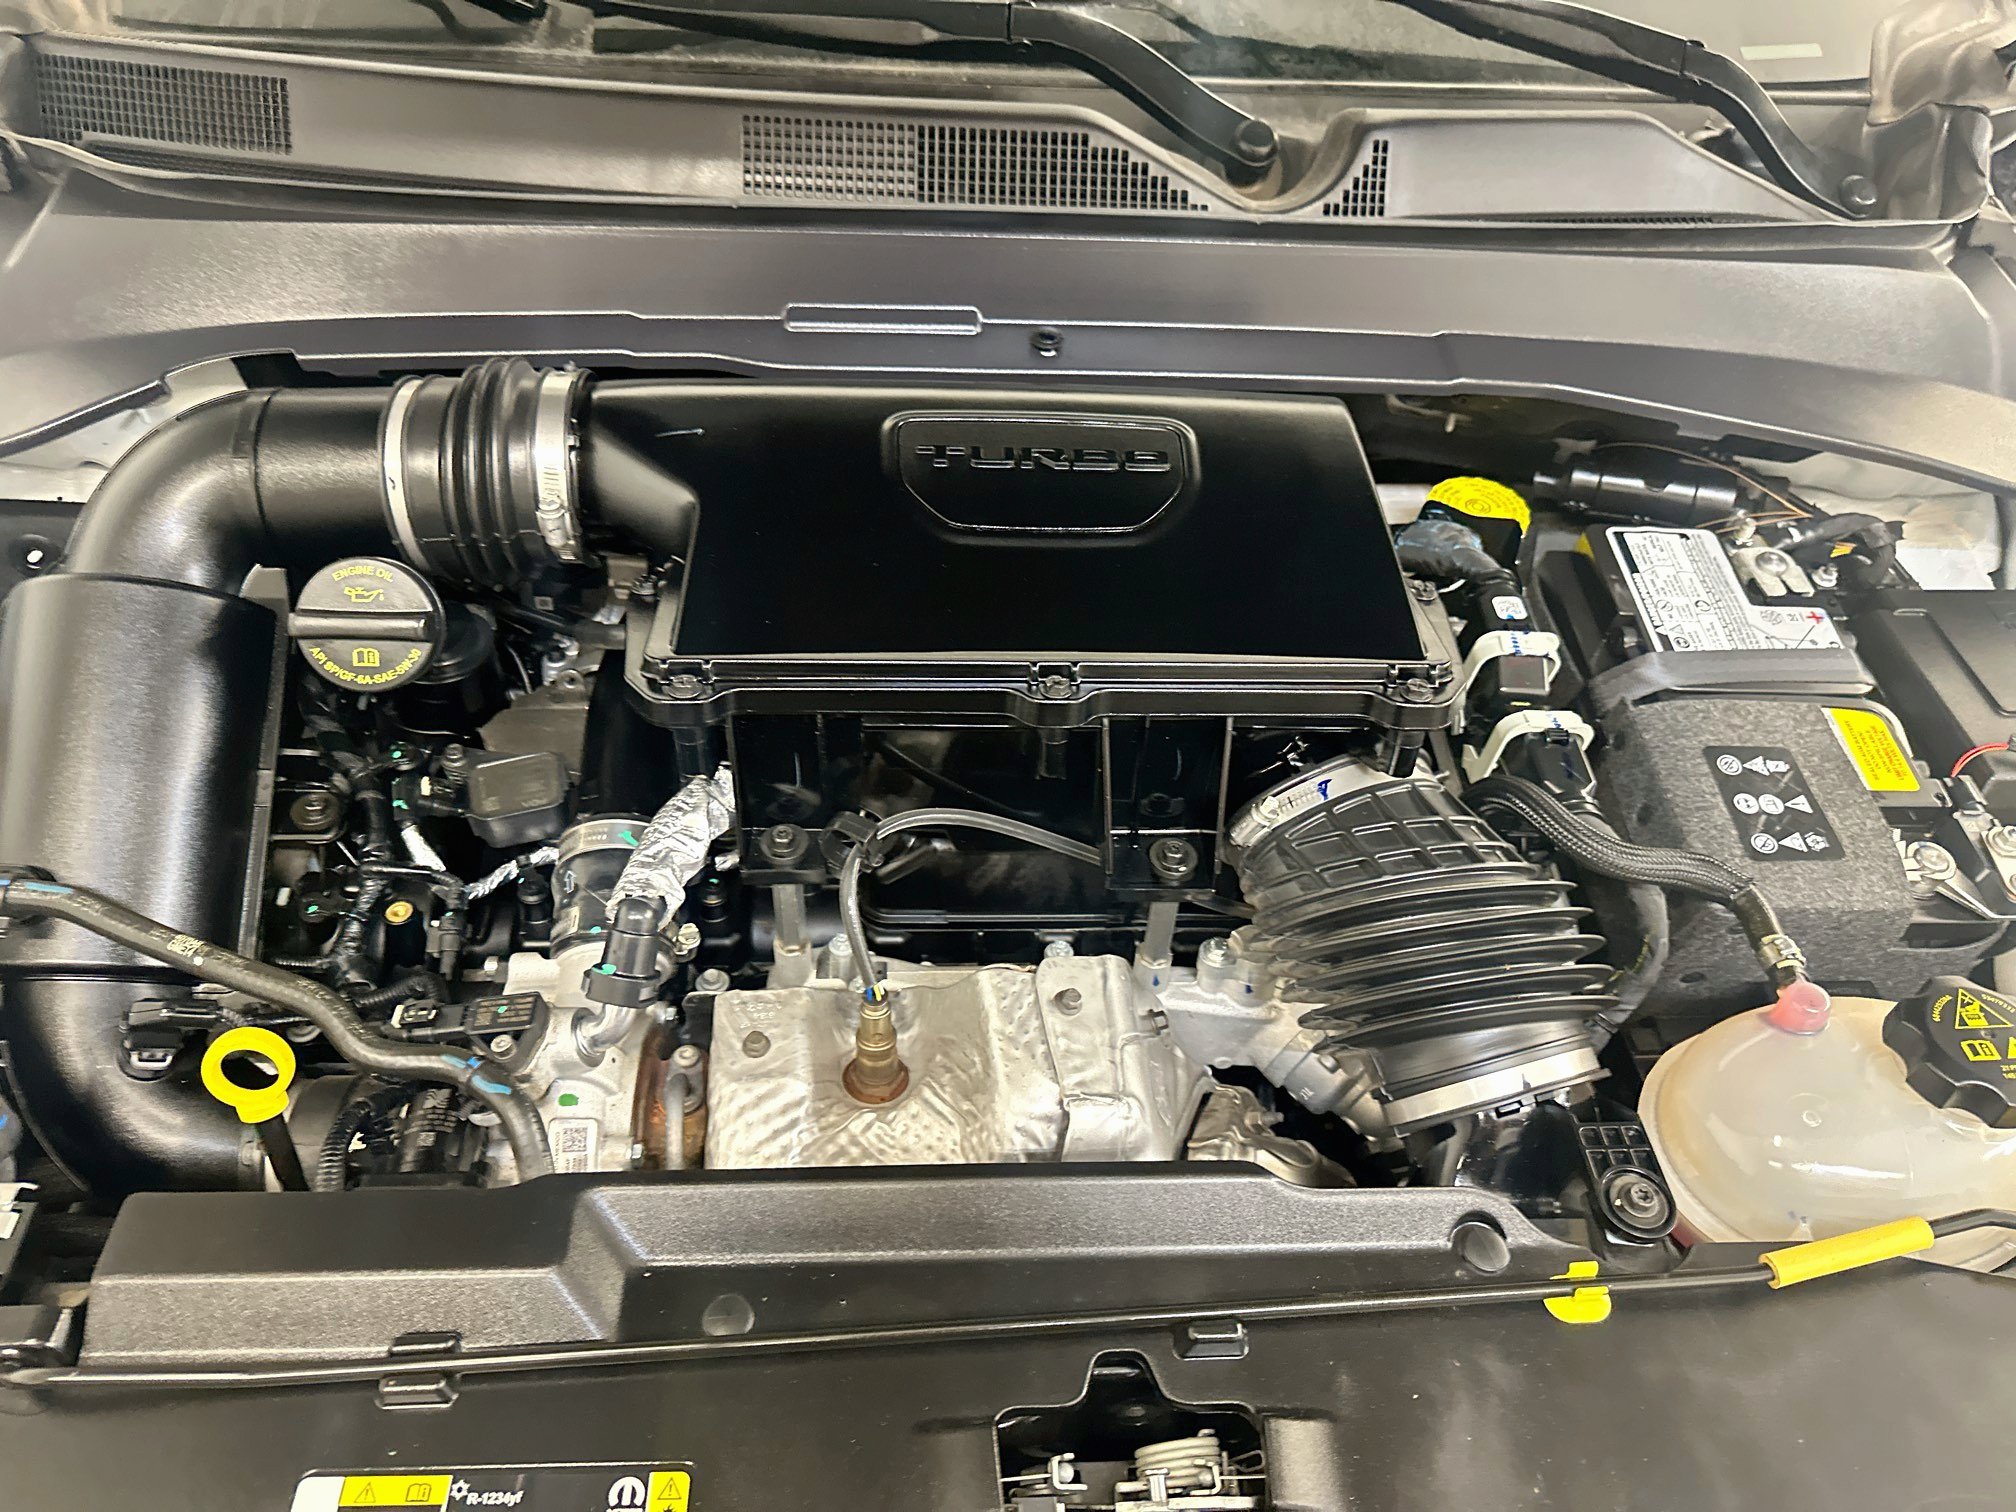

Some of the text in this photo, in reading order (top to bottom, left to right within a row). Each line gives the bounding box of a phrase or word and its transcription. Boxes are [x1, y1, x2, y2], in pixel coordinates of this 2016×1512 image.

[915, 446, 1172, 471] TURBO
[332, 565, 394, 583] ENGINE OIL
[309, 647, 329, 665] API
[466, 1490, 524, 1507] R-1234yf
